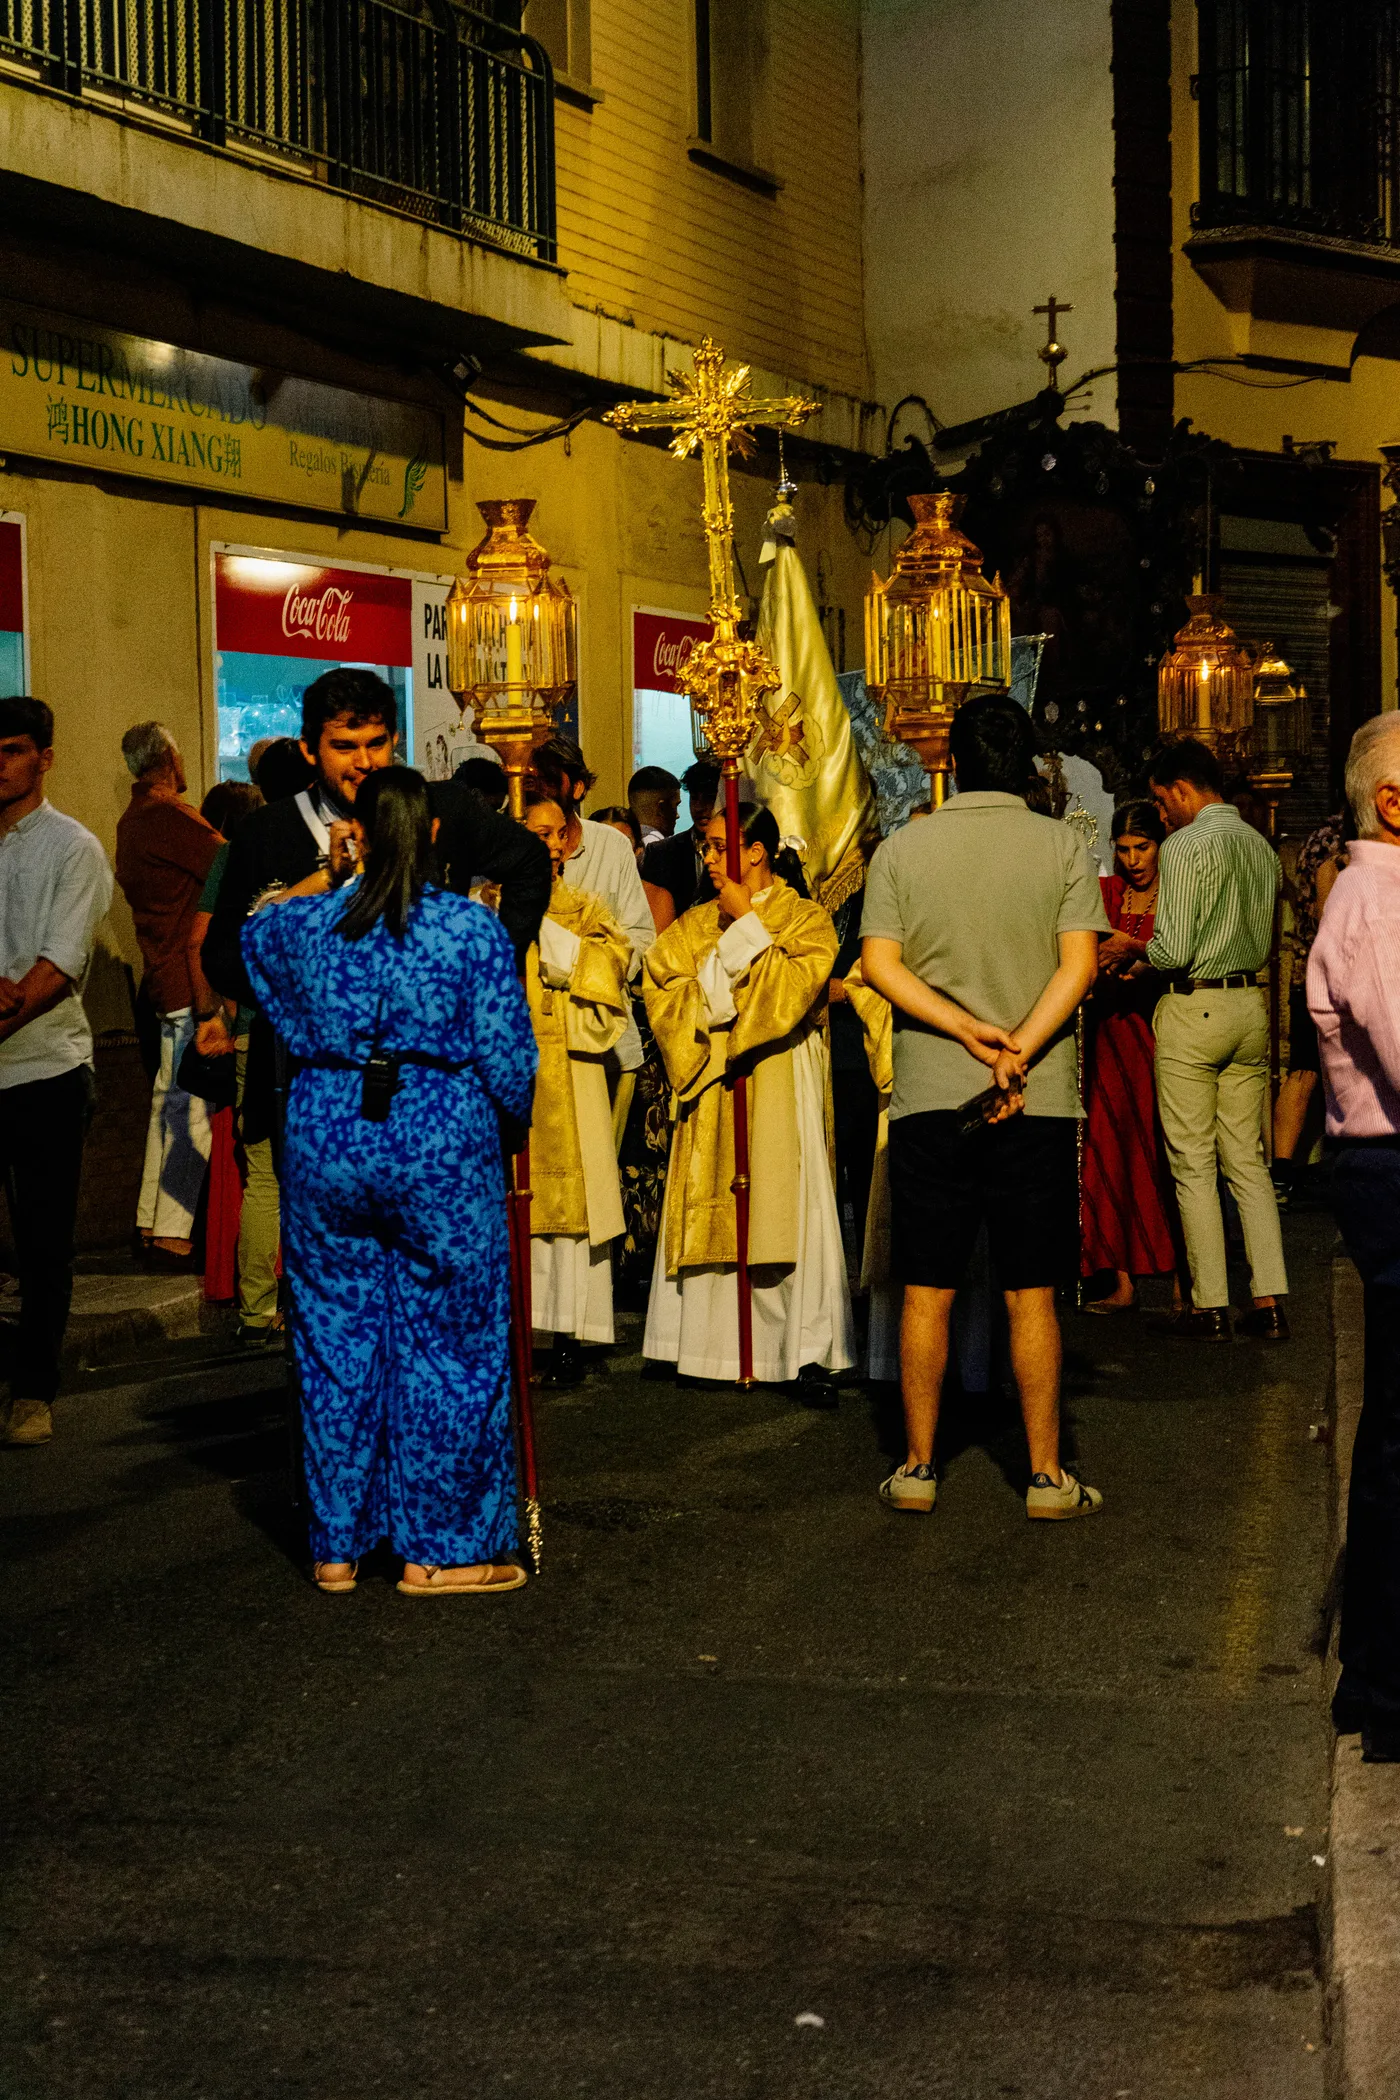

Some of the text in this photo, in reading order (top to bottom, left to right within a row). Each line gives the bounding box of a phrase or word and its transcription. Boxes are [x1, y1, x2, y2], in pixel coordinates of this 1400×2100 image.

[11, 322, 268, 430] SUPERMERCADO
[71, 403, 144, 457] HONG
[151, 421, 223, 473] XIANG
[289, 440, 391, 486] Regalos Bisuería
[282, 582, 354, 643] Coca-Cola
[424, 603, 448, 641] PAR
[427, 652, 443, 690] LA
[653, 631, 697, 676] Coca-C
